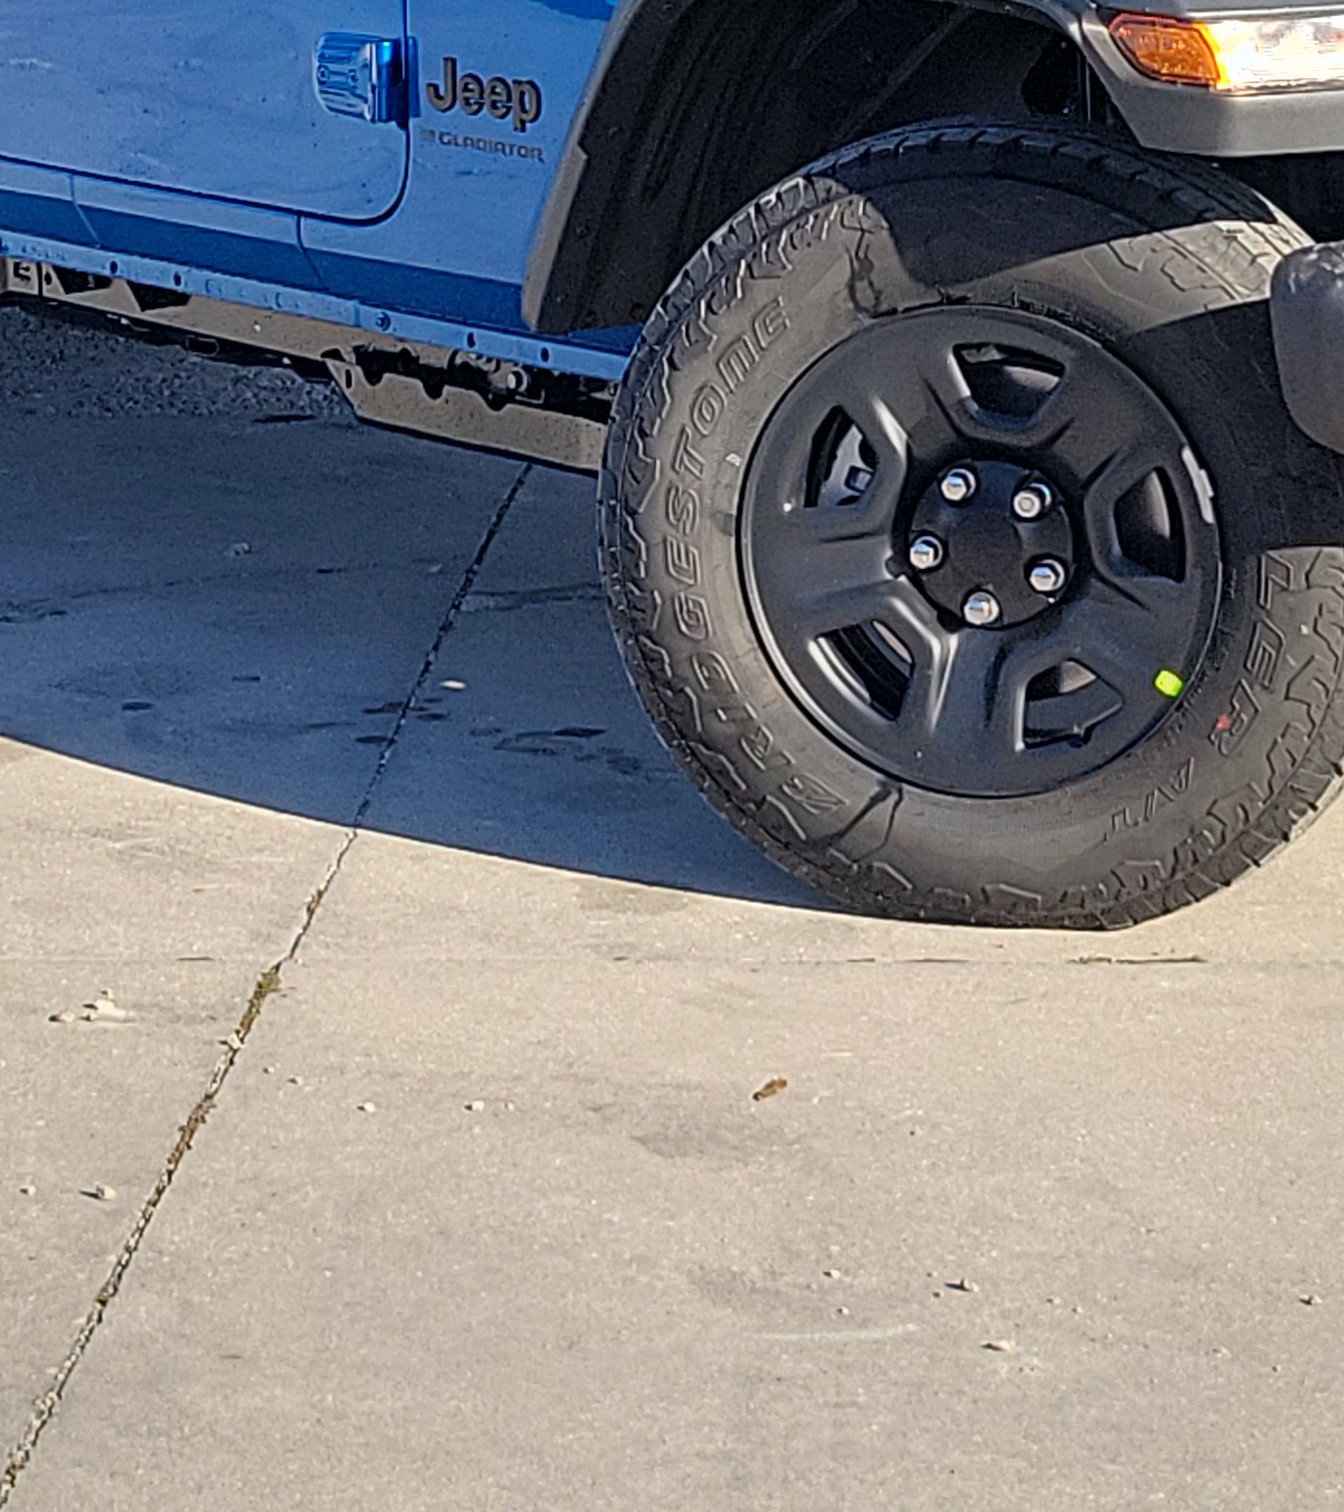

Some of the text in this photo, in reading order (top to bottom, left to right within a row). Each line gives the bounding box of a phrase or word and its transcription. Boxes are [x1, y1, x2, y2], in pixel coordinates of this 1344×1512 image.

[426, 57, 542, 132] Jeep
[440, 131, 545, 163] GLADIATOR
[664, 294, 850, 816] BRIDGESTONE
